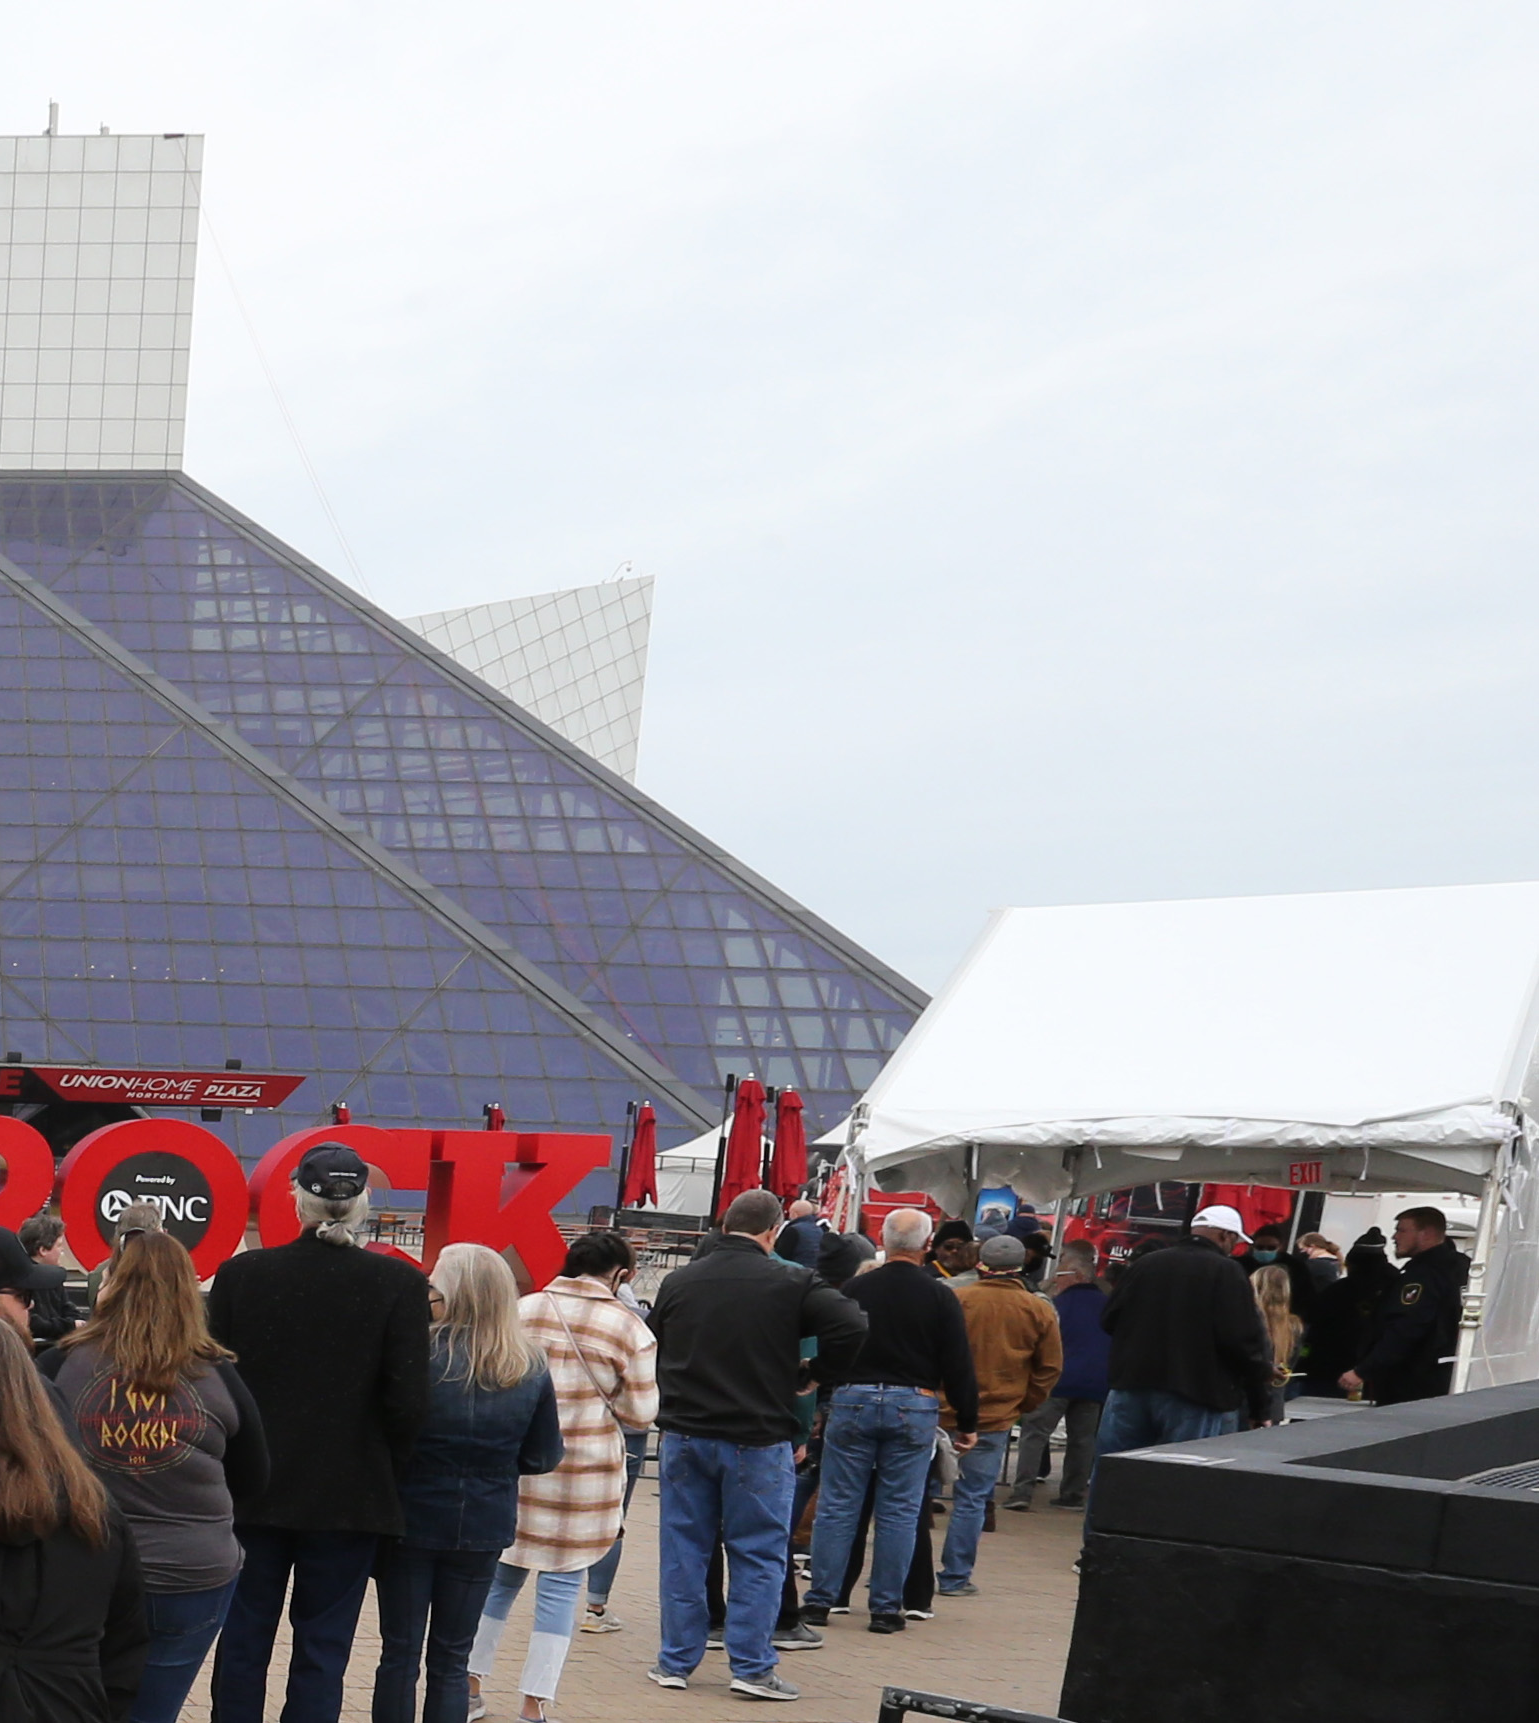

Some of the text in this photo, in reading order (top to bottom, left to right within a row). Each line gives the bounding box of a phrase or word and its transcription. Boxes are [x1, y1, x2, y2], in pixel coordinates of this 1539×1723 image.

[125, 1091, 193, 1100] MORTGAGE
[203, 1084, 261, 1098] PLAZA
[135, 1174, 176, 1186] Powered by
[1289, 1161, 1323, 1186] EXIT
[101, 1418, 178, 1450] ROCKED!
